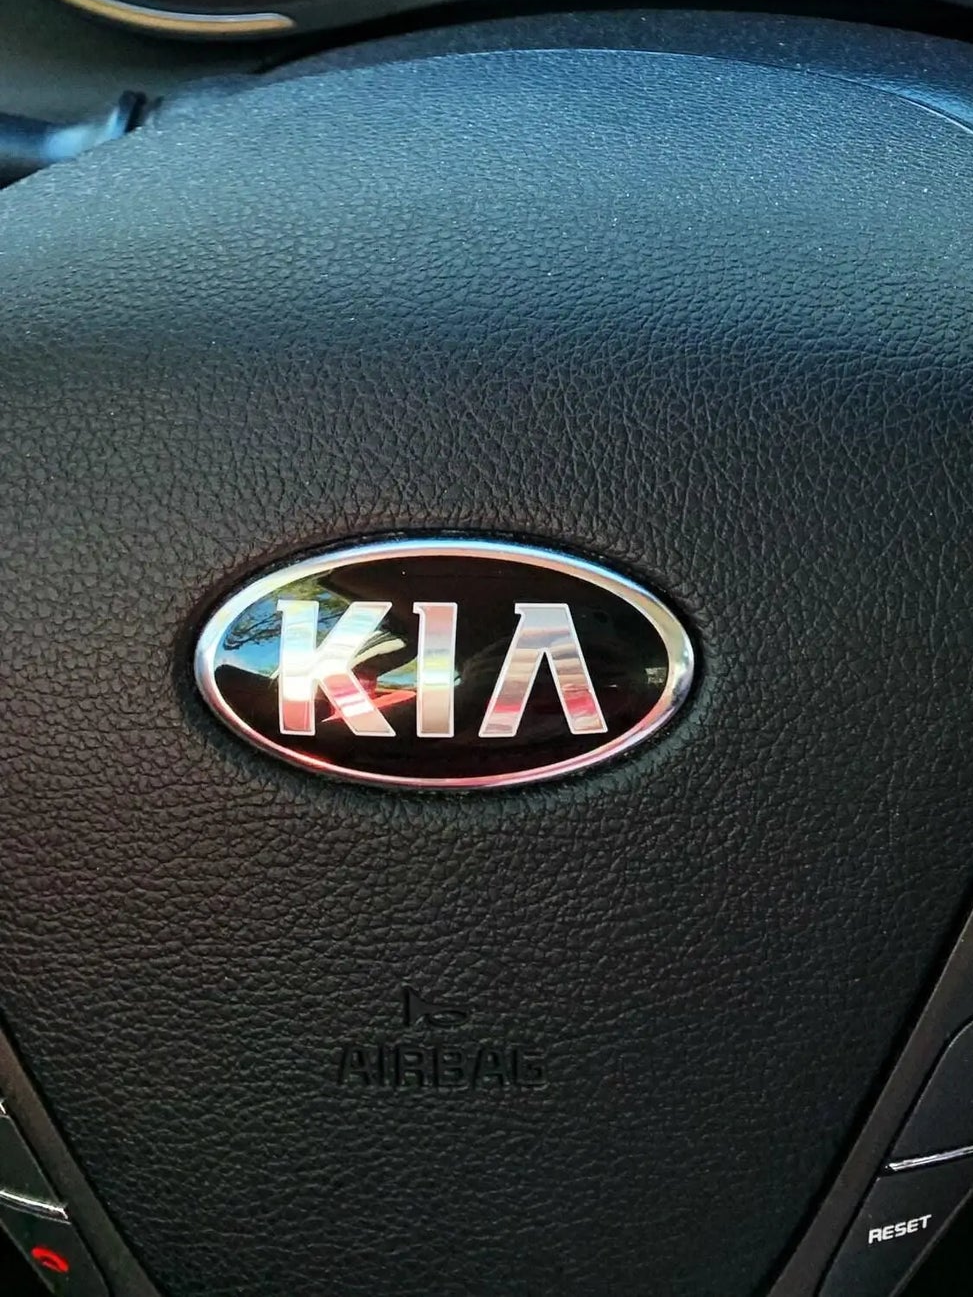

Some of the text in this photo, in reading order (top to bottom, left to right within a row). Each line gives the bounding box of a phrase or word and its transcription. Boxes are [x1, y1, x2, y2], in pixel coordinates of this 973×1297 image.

[277, 598, 609, 738] KIA
[336, 1044, 547, 1090] AIRBAG
[867, 1215, 933, 1245] RESET
